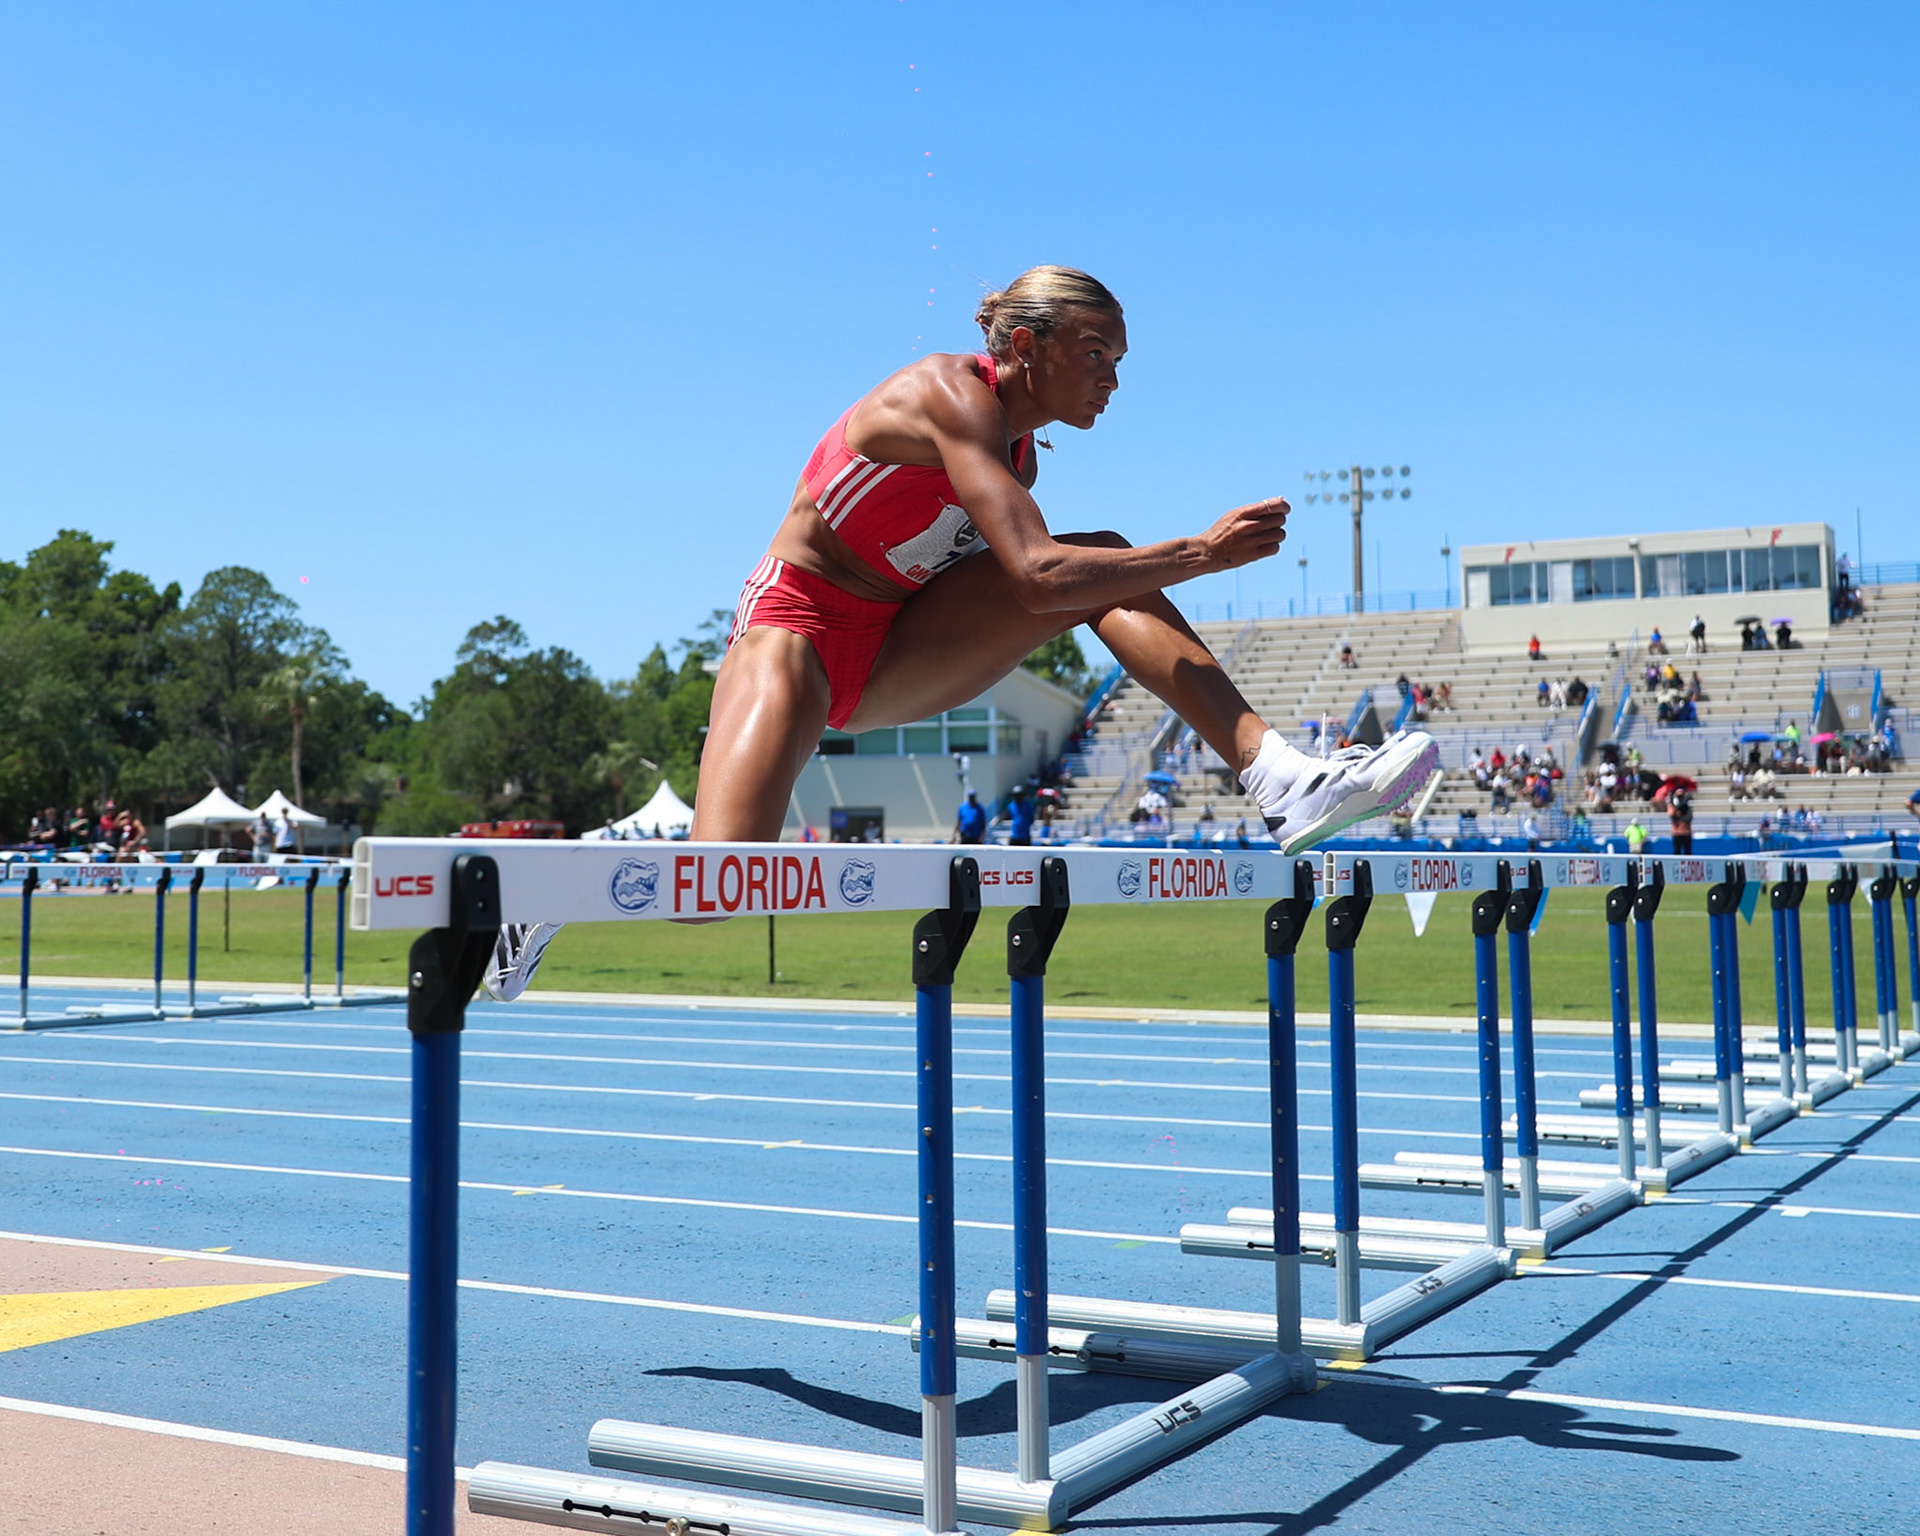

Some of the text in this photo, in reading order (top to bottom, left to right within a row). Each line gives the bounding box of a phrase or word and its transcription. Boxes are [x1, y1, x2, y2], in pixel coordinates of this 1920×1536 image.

[79, 867, 123, 878] FLORIDA
[239, 867, 277, 876] FLORIDA
[1006, 871, 1034, 885] UCS
[1149, 858, 1228, 898] FLORIDA
[1412, 859, 1458, 890] FLORIDA
[375, 876, 434, 897] UCS
[674, 855, 826, 912] FLORIDA
[1409, 1275, 1443, 1295] UCS
[1152, 1400, 1202, 1434] UCS
